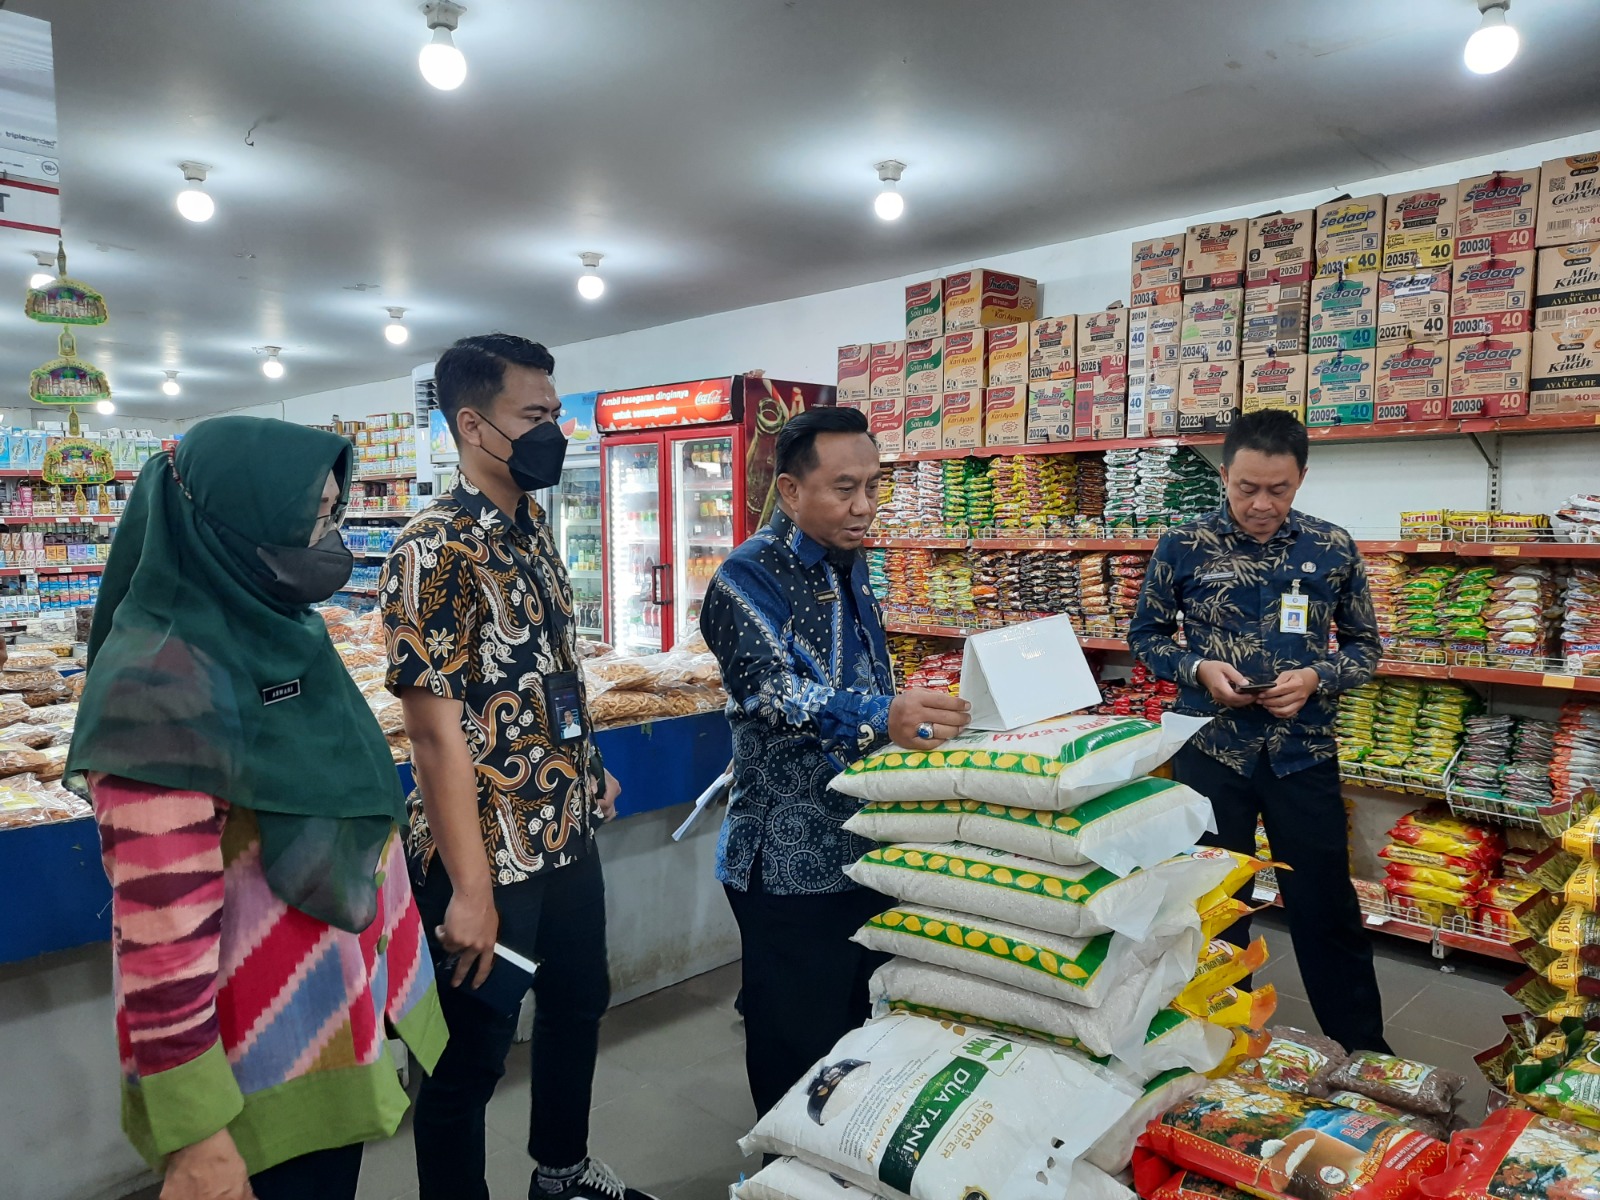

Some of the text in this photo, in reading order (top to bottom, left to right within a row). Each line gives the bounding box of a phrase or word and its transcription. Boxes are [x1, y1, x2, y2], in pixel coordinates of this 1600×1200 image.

[1463, 183, 1532, 202] Sedaap
[1571, 178, 1594, 194] Mi
[1552, 186, 1600, 206] Goren
[1395, 197, 1447, 213] Sedaap
[1319, 210, 1376, 229] Sedaap
[1518, 213, 1527, 224] 9
[1258, 222, 1303, 237] Sedaap
[1440, 228, 1449, 237] 9
[1366, 237, 1374, 246] 9
[1508, 230, 1530, 246] 40
[1430, 243, 1451, 259] 40
[1459, 238, 1490, 254] 20030
[1358, 253, 1376, 267] 40
[1386, 252, 1416, 267] 20357
[1171, 272, 1178, 280] 9
[1280, 265, 1302, 276] 20267
[1458, 266, 1525, 283] Sedaap
[1570, 266, 1591, 279] Mi
[988, 276, 1017, 291] Indomie
[1387, 275, 1438, 291] Sedaap
[1553, 271, 1600, 290] Kuah
[1165, 286, 1180, 298] 40
[1314, 286, 1371, 302] Sedaap
[1511, 295, 1521, 306] 9
[1551, 296, 1578, 306] AYAM
[923, 307, 933, 315] Mie
[1432, 303, 1441, 313] 9
[1582, 307, 1597, 315] 40
[1150, 320, 1178, 330] Sedaap
[1361, 314, 1368, 323] 9
[1423, 316, 1444, 333] 40
[1501, 312, 1523, 327] 40
[1224, 326, 1231, 334] 9
[1379, 325, 1408, 339] 20277
[1453, 318, 1485, 334] 20030
[1131, 332, 1145, 343] 40
[1311, 334, 1338, 349] 20092
[1352, 329, 1371, 343] 40
[1216, 340, 1232, 352] 40
[949, 356, 977, 366] Kari Ayam
[993, 351, 1022, 361] Kari Ayam
[1109, 355, 1123, 366] 40
[1454, 348, 1522, 363] Sedaap
[1563, 352, 1583, 364] Mi
[910, 363, 922, 371] Soto
[1058, 361, 1071, 372] 40
[1312, 362, 1370, 375] Sedaap
[1380, 355, 1443, 371] Sedaap
[1547, 357, 1594, 374] Kuah
[1251, 366, 1296, 378] Sedaap
[1509, 377, 1518, 387] 9
[1545, 379, 1597, 390] AYAM CABE
[1147, 387, 1174, 396] Sedaap
[1359, 389, 1367, 398] 9
[1431, 384, 1440, 394] 9
[1129, 397, 1142, 408] 40
[1223, 397, 1230, 405] 9
[1290, 395, 1297, 403] 9
[1500, 394, 1521, 408] 40
[1575, 393, 1591, 401] 40
[1350, 404, 1370, 418] 40
[1378, 404, 1406, 418] 20030
[1422, 400, 1442, 414] 40
[1452, 399, 1482, 413] 20030
[959, 415, 975, 424] Ayam
[1002, 411, 1019, 419] Ayam
[1114, 417, 1120, 425] 9
[1180, 414, 1204, 427] 20234
[1216, 410, 1232, 424] 40
[1310, 409, 1336, 422] 20092
[1056, 425, 1069, 435] 40
[992, 726, 1069, 742] KEPALA
[1558, 905, 1576, 934] BERAS
[901, 1072, 928, 1099] MUTU
[933, 1067, 971, 1103] DUA
[866, 1103, 903, 1164] TERJAMIN
[902, 1107, 942, 1154] TANI
[961, 1112, 994, 1150] BERAS
[941, 1122, 972, 1160] SUPER
